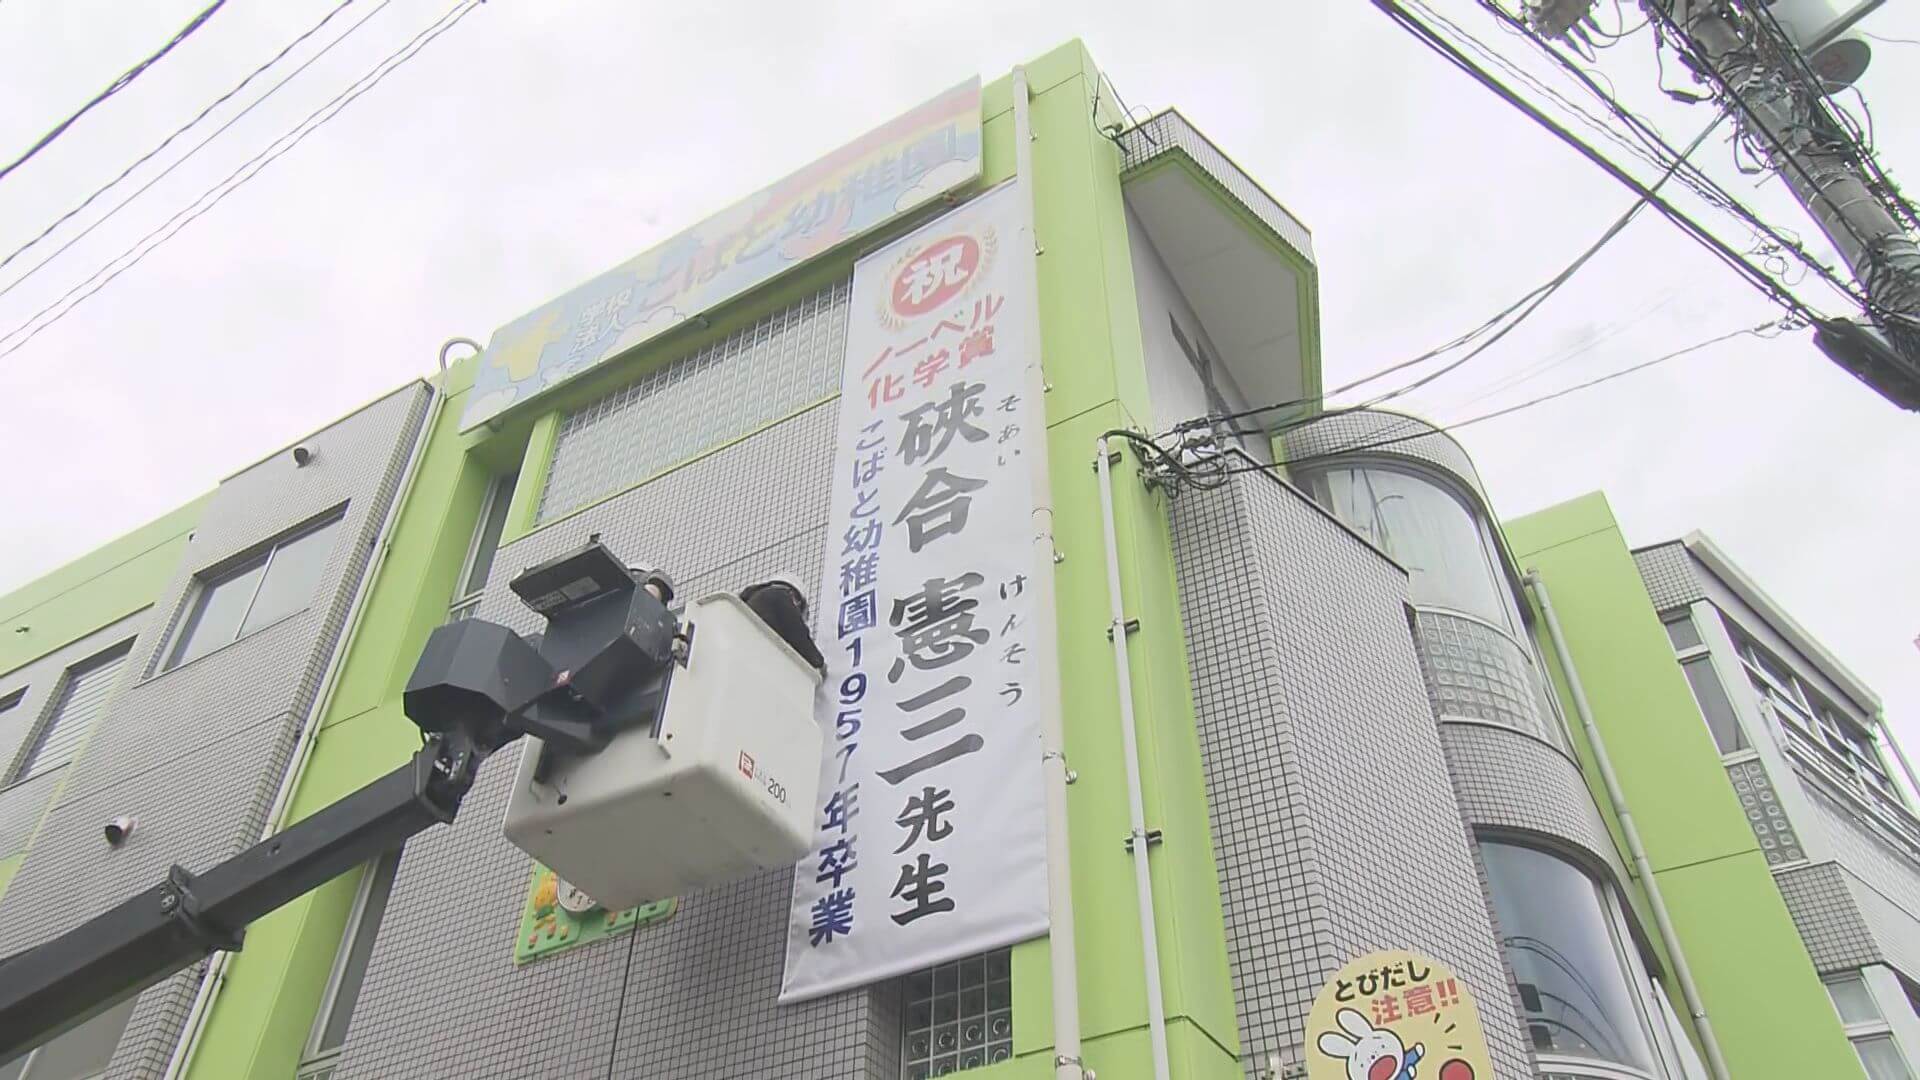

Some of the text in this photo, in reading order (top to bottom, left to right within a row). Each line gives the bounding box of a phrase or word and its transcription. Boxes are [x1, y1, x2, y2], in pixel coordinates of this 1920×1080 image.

[900, 243, 969, 305] 祝
[862, 294, 1004, 381] ノーベル
[868, 325, 996, 410] 化学賞
[997, 394, 1027, 706] そあい けんそう
[808, 419, 887, 948] こばと幼稚園1957年卒業
[768, 778, 786, 803] 200
[1335, 960, 1430, 1002] とびだし
